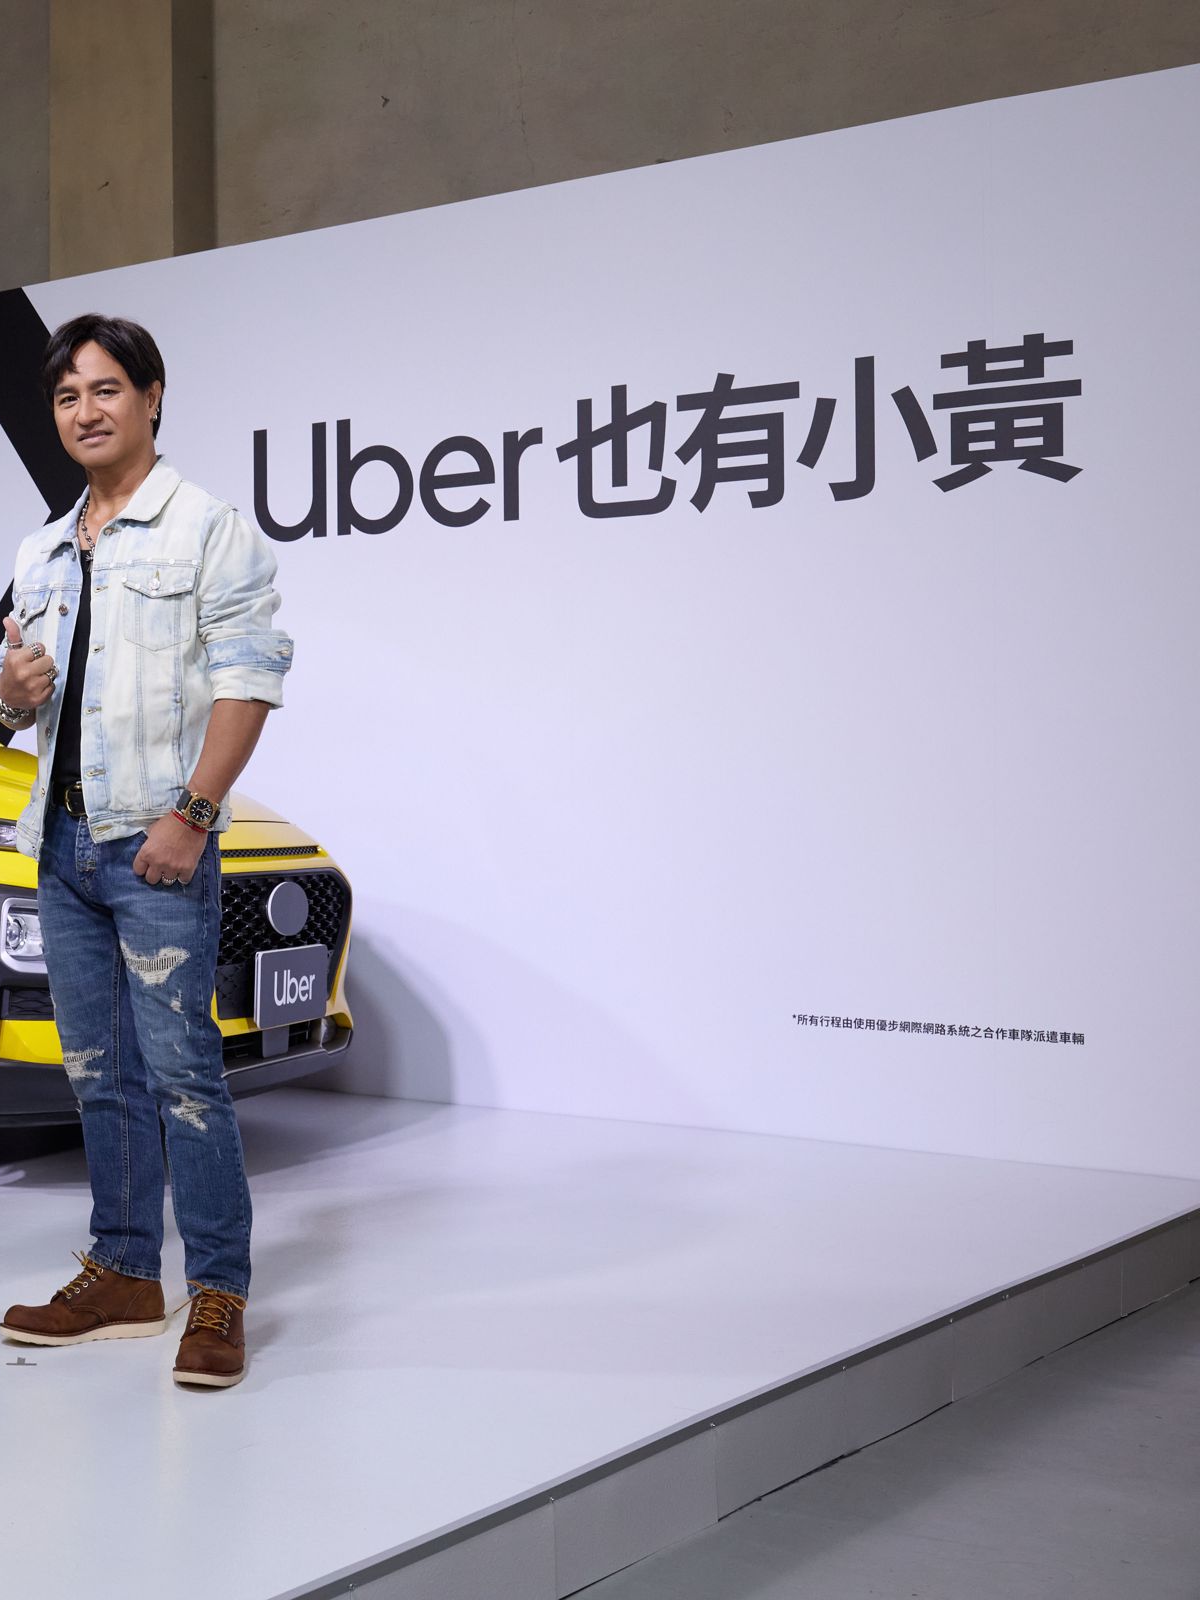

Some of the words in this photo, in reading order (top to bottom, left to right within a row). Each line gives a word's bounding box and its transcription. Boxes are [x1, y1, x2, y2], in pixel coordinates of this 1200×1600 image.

[253, 418, 543, 543] Uber
[555, 332, 1084, 519] 也有小黃
[273, 969, 316, 1007] Uber
